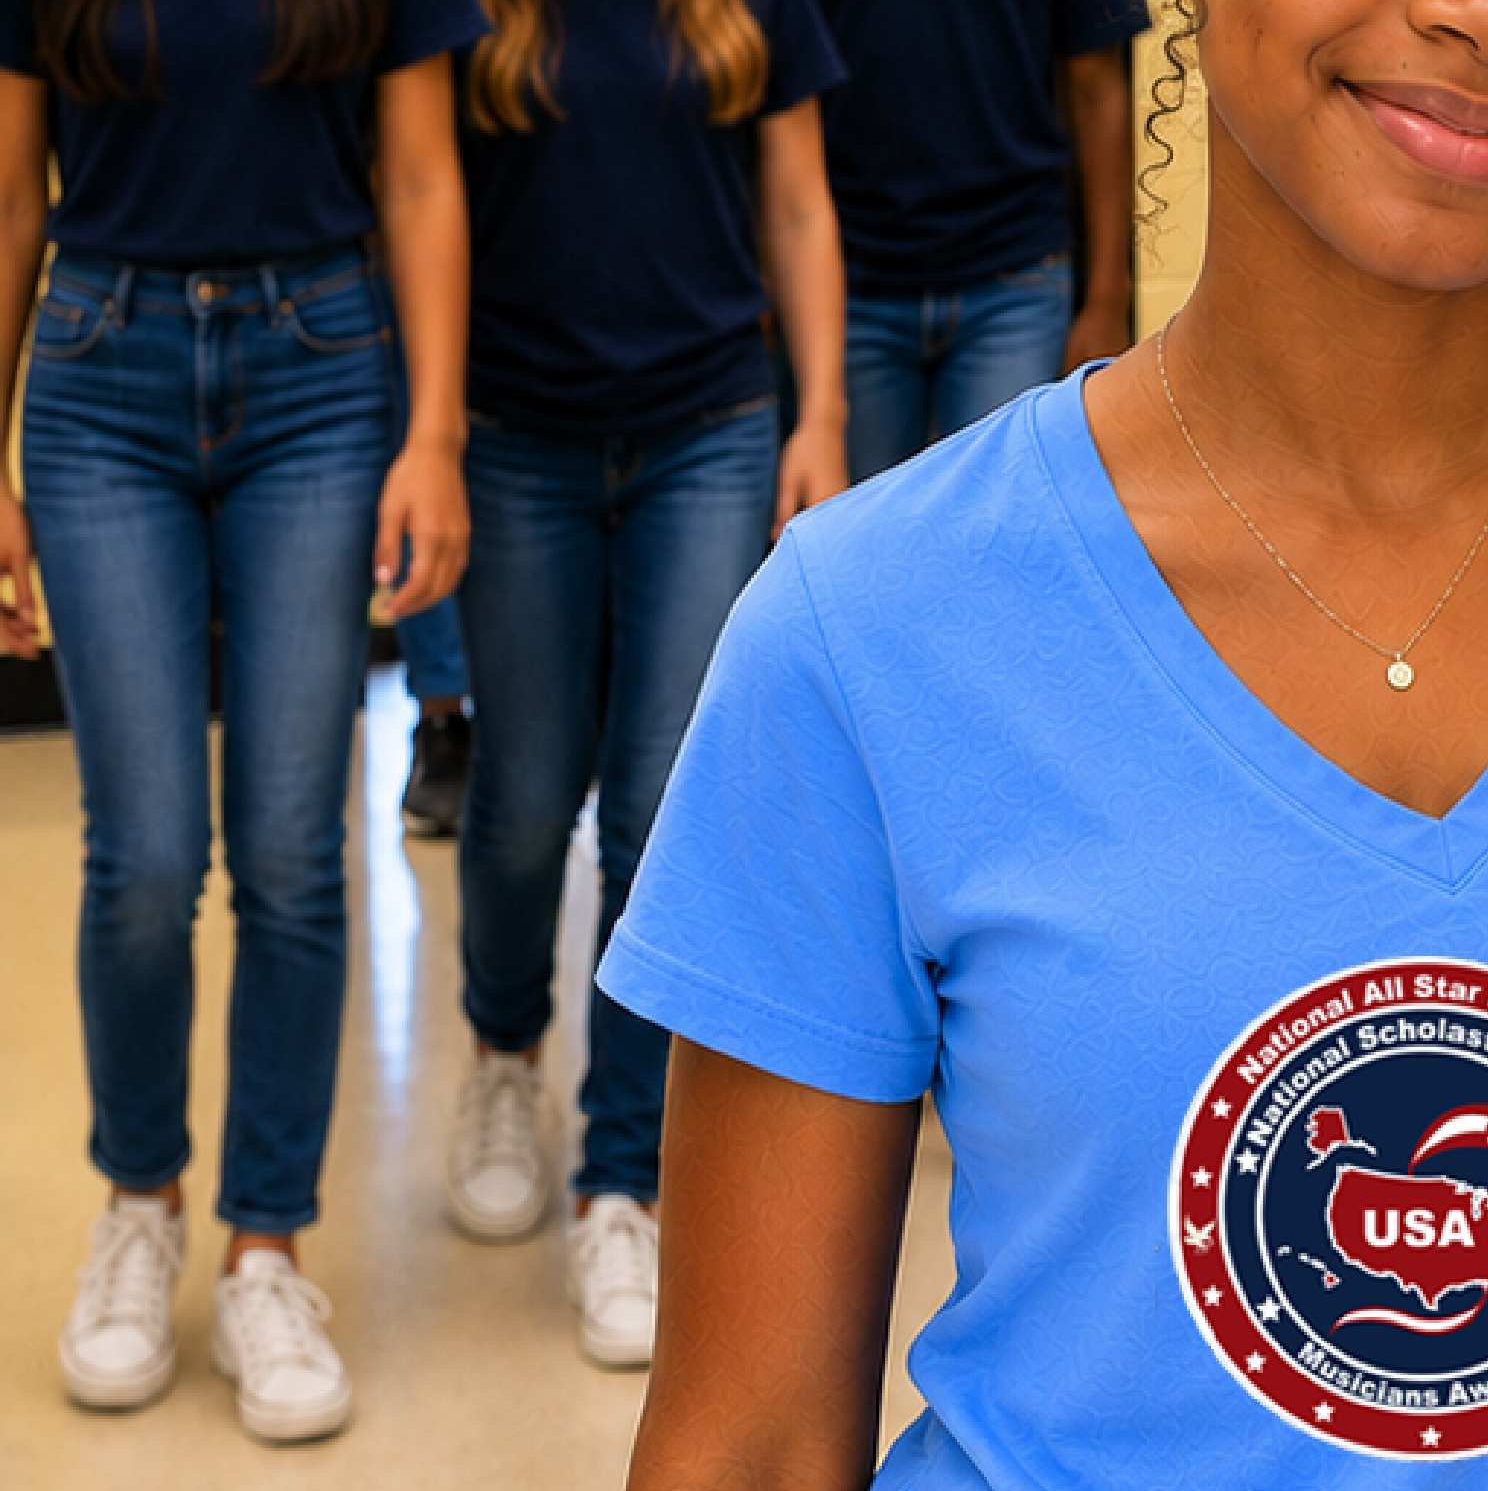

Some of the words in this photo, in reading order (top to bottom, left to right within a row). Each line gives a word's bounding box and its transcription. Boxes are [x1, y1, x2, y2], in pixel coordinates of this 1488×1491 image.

[1237, 990, 1353, 1085] National
[1363, 976, 1404, 1006] All
[1413, 974, 1479, 1003] Star
[1246, 1042, 1351, 1145] National
[1363, 1209, 1475, 1248] USA
[1298, 1342, 1439, 1408] Musicians
